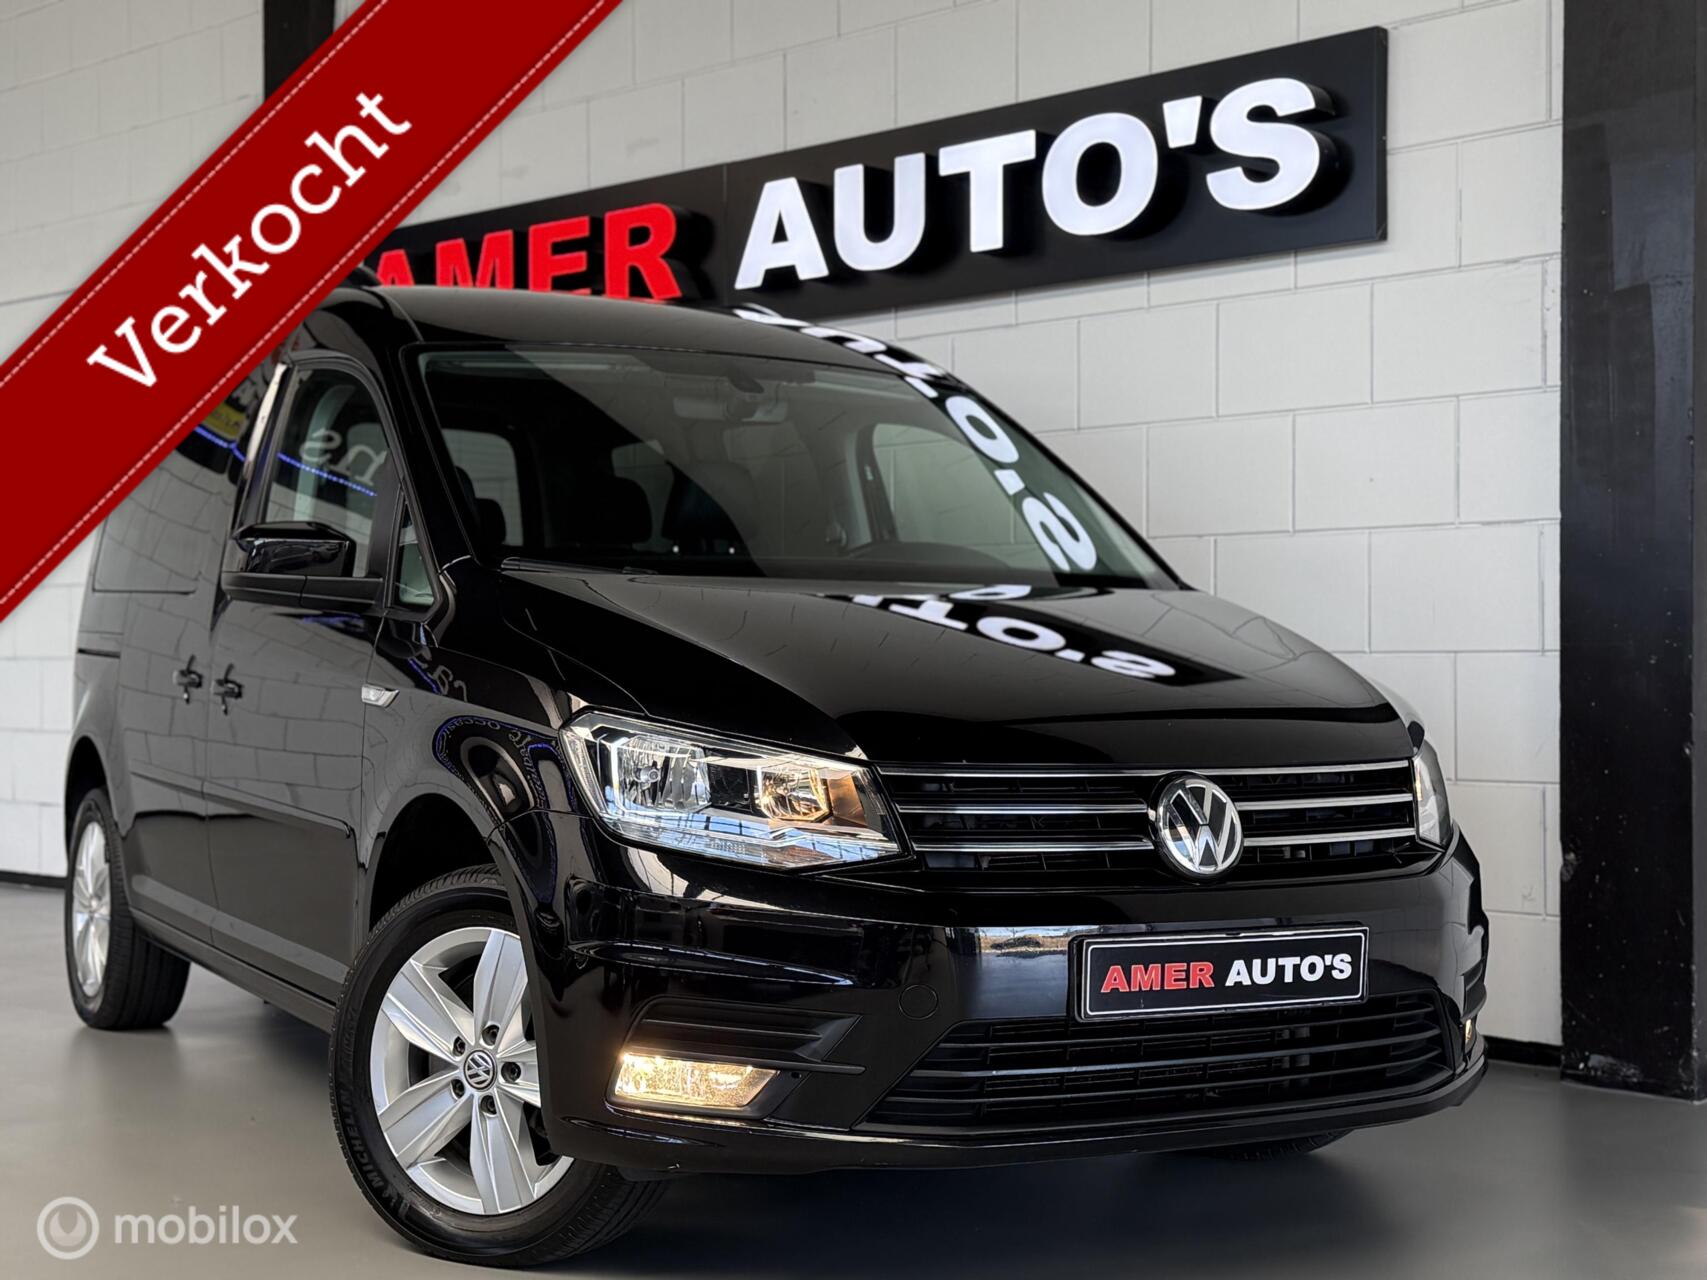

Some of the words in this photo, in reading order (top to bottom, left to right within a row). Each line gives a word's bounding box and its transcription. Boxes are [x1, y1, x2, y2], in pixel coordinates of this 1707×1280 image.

[376, 203, 682, 305] AMER
[736, 78, 1320, 290] AUTO'S
[1100, 961, 1214, 993] AMER
[1225, 953, 1353, 986] AUTO'S
[340, 1088, 385, 1189] MICHELIN
